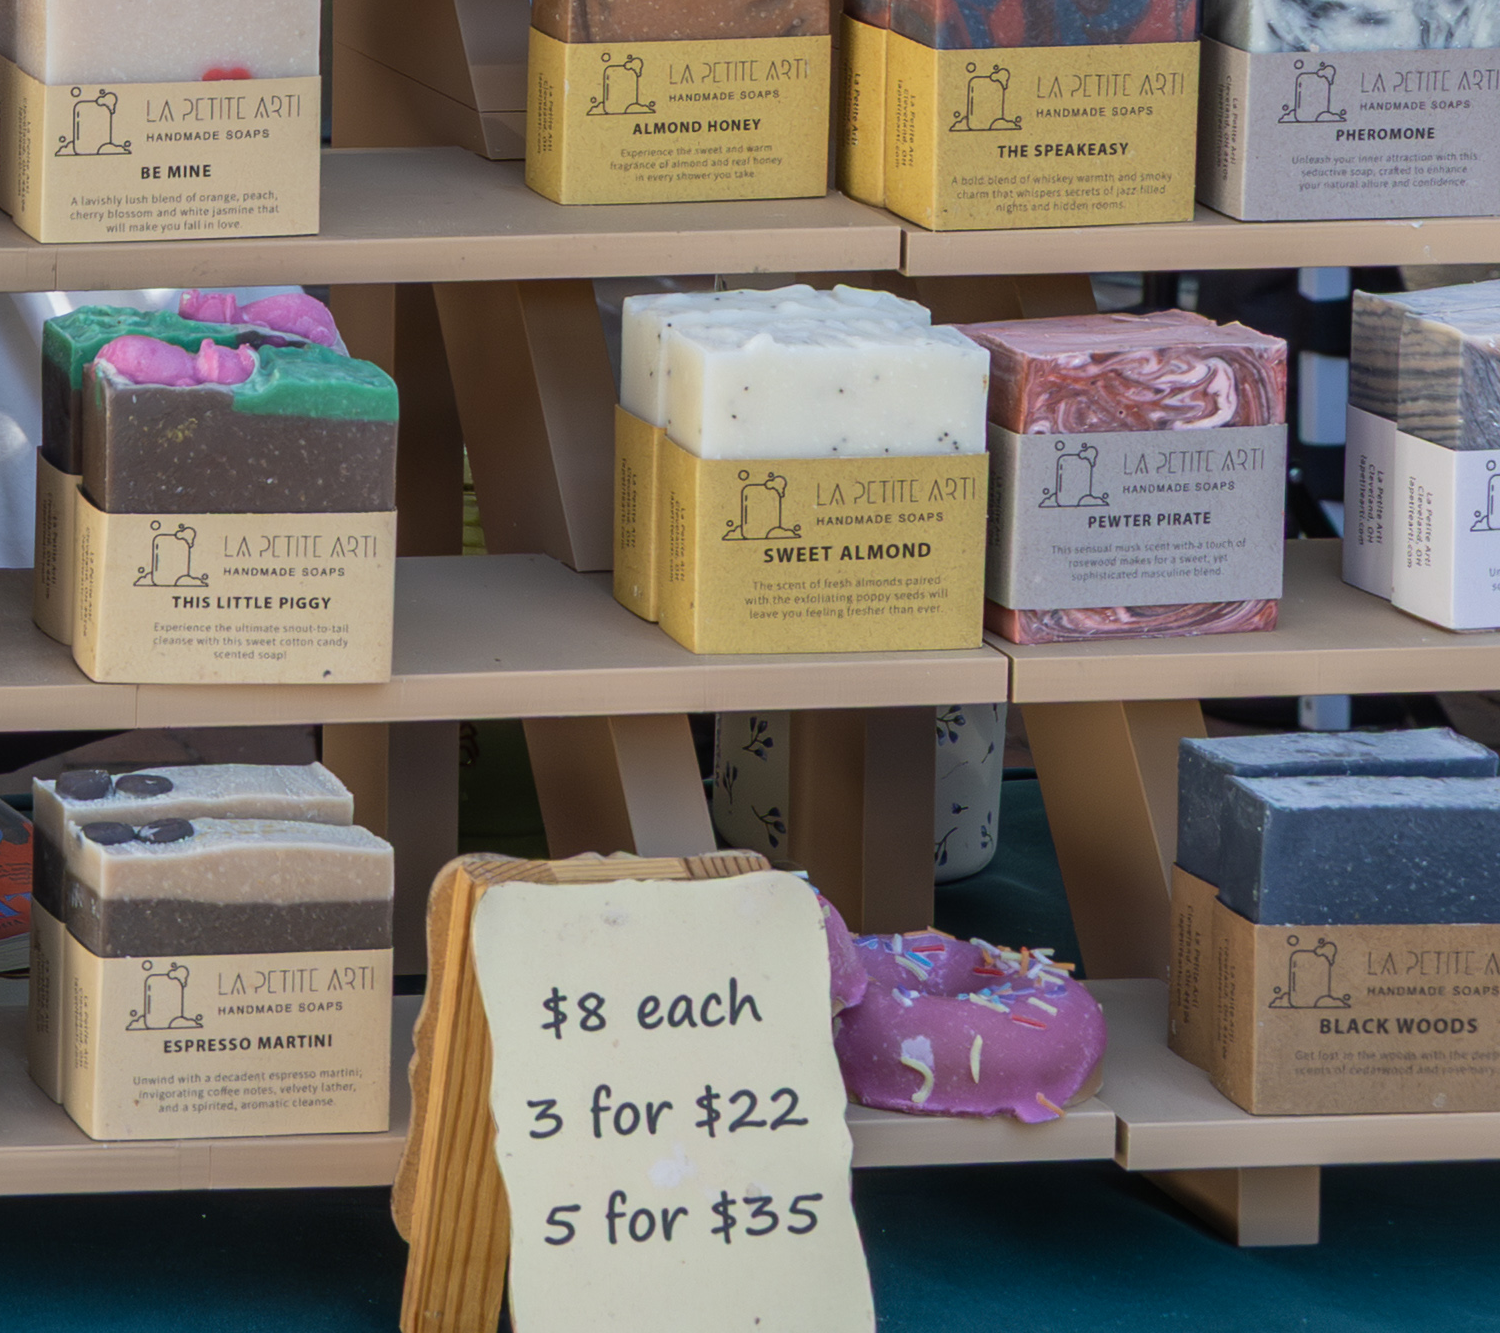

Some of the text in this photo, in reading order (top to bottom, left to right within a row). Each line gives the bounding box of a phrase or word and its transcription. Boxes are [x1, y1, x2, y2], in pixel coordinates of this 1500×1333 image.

[632, 118, 761, 135] ALMOND HONEY
[1335, 127, 1435, 142] PHEROMONE
[997, 142, 1129, 159] THE SPEAKEASY
[140, 164, 212, 180] BE MINE
[816, 477, 976, 506] LA PETITE ARTI
[816, 511, 944, 526] HANDMADE SOAPS
[1087, 511, 1211, 529] PEWTER PIRATE
[1424, 491, 1434, 568] La Petite Arti
[763, 542, 931, 564] SWEET ALMOND
[171, 595, 331, 610] THIS LITTLE PIGGY
[541, 976, 763, 1040] $8 each
[1319, 1017, 1478, 1035] BLACK WOODS
[163, 1033, 333, 1054] ESPRESSO MARTINI
[526, 1083, 809, 1140] 3 for $22
[544, 1189, 824, 1246] 5 for $35
